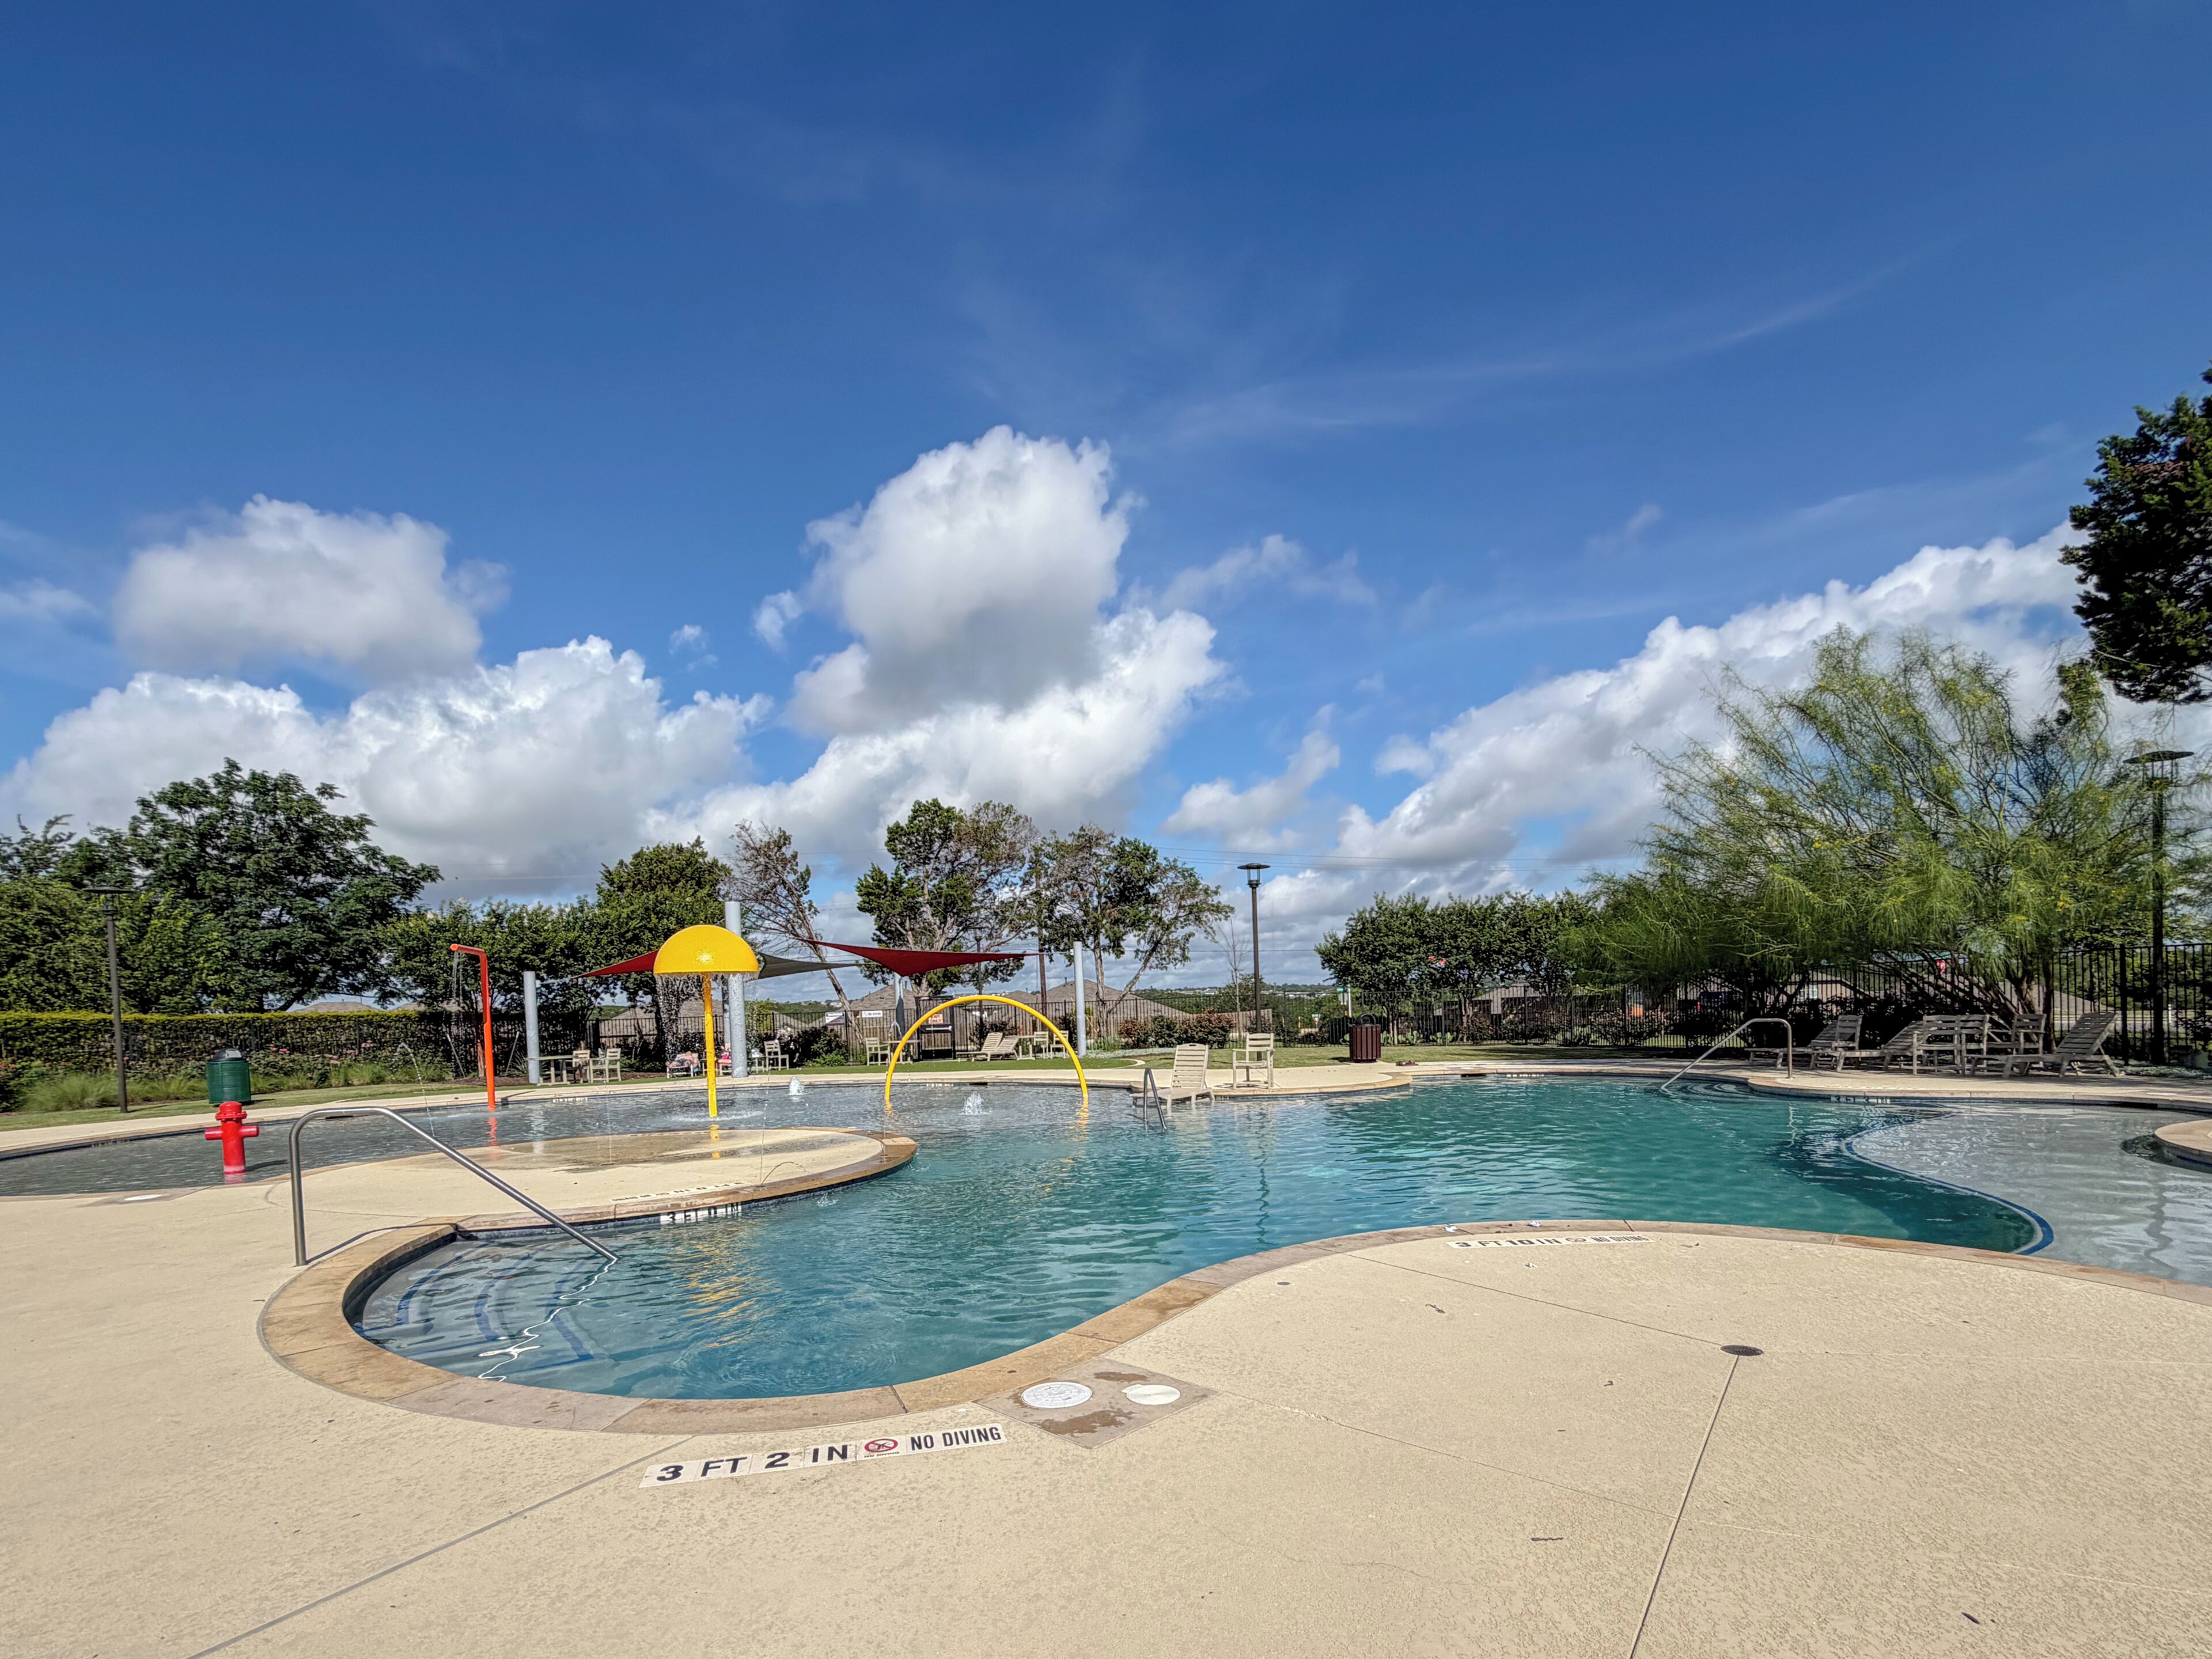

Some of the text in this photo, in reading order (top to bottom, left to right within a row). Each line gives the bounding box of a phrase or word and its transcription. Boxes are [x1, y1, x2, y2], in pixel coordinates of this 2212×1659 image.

[657, 1427, 1001, 1481] 3 FT 2 IN NO DIVING
